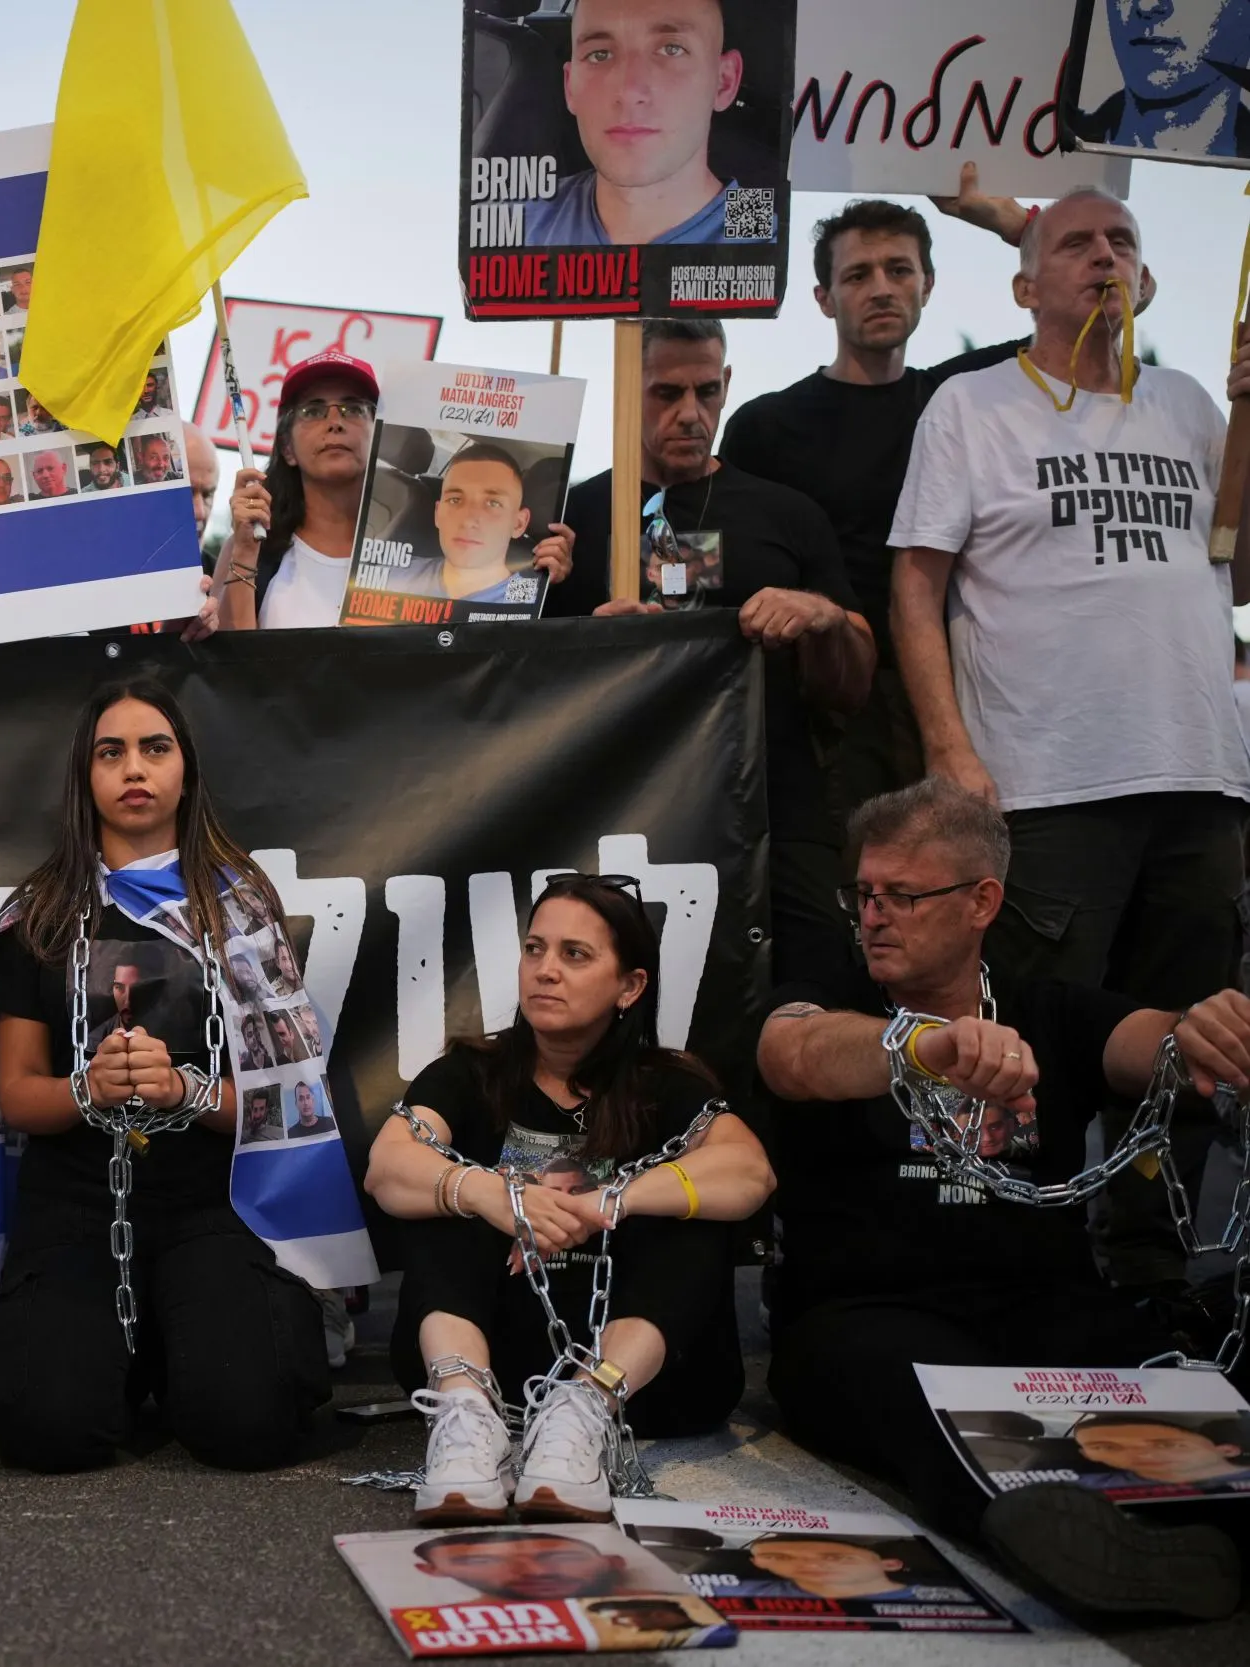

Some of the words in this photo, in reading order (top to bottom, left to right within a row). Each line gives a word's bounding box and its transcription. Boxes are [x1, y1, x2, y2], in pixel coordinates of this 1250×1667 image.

[470, 154, 557, 202] BRING
[469, 202, 524, 248] HIM
[470, 253, 548, 299] HOME
[557, 247, 640, 298] NOW!
[671, 265, 716, 281] HOSTAGES
[717, 265, 735, 281] AND
[736, 265, 776, 281] MISSING
[670, 280, 728, 301] FAMILIES
[730, 280, 775, 301] FORUM
[440, 387, 476, 405] MATAN
[477, 391, 526, 411] ANGREST
[1035, 453, 1089, 490] את
[1094, 451, 1200, 491] תחזירו
[1051, 488, 1193, 531] החטופים
[359, 537, 414, 568] BRING
[355, 563, 390, 591] HIM
[349, 591, 399, 619] HOME
[400, 599, 453, 624] NOW!
[899, 1164, 938, 1180] BRING
[1013, 1382, 1069, 1393] MATAN
[1071, 1382, 1143, 1393] ANGREST
[438, 1603, 561, 1632] מתן
